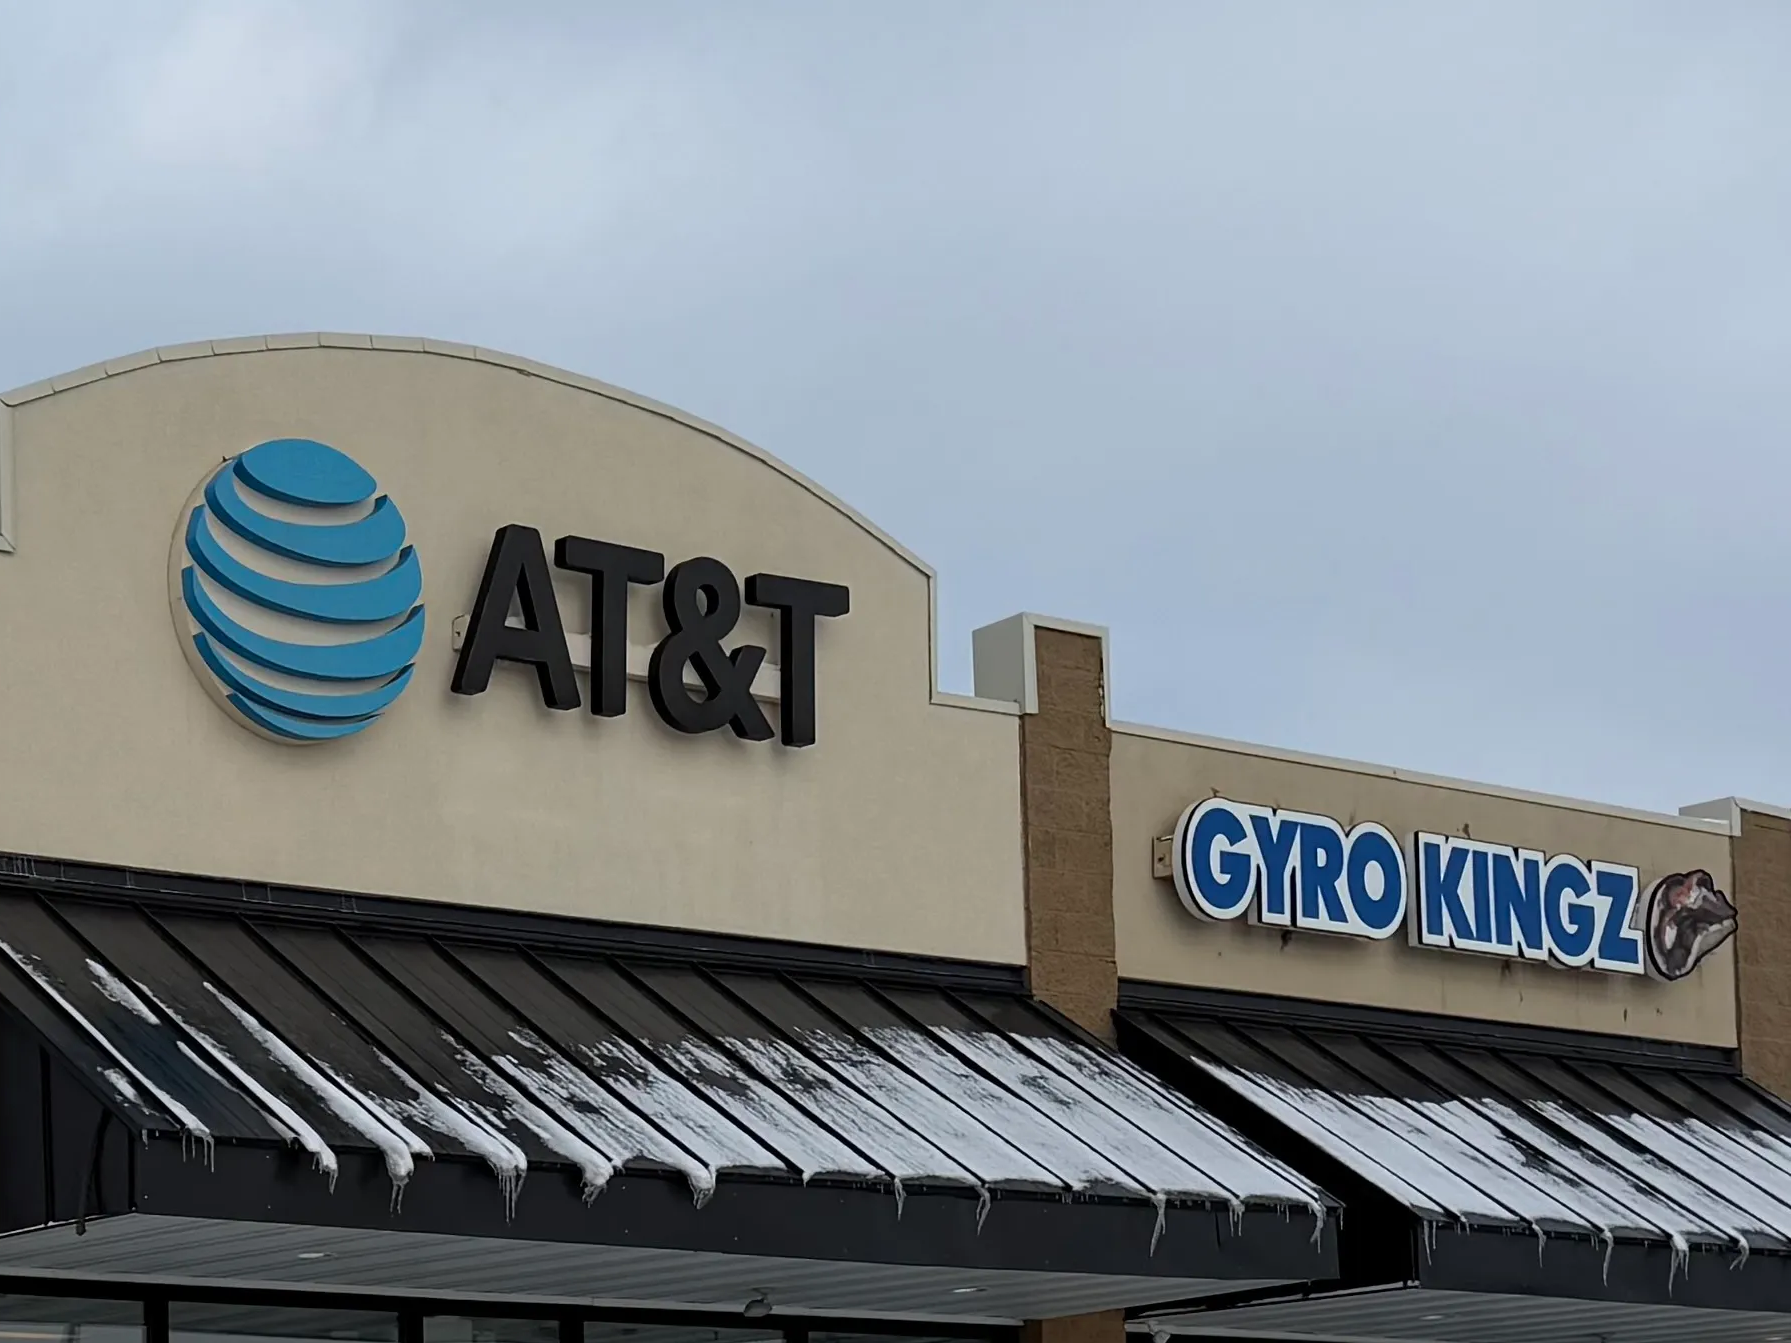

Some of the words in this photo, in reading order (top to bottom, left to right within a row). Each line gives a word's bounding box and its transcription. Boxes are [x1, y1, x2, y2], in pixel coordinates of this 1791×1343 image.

[450, 523, 850, 748] AT&T
[1189, 805, 1407, 932] GYRO
[1421, 836, 1643, 966] KINGZ
